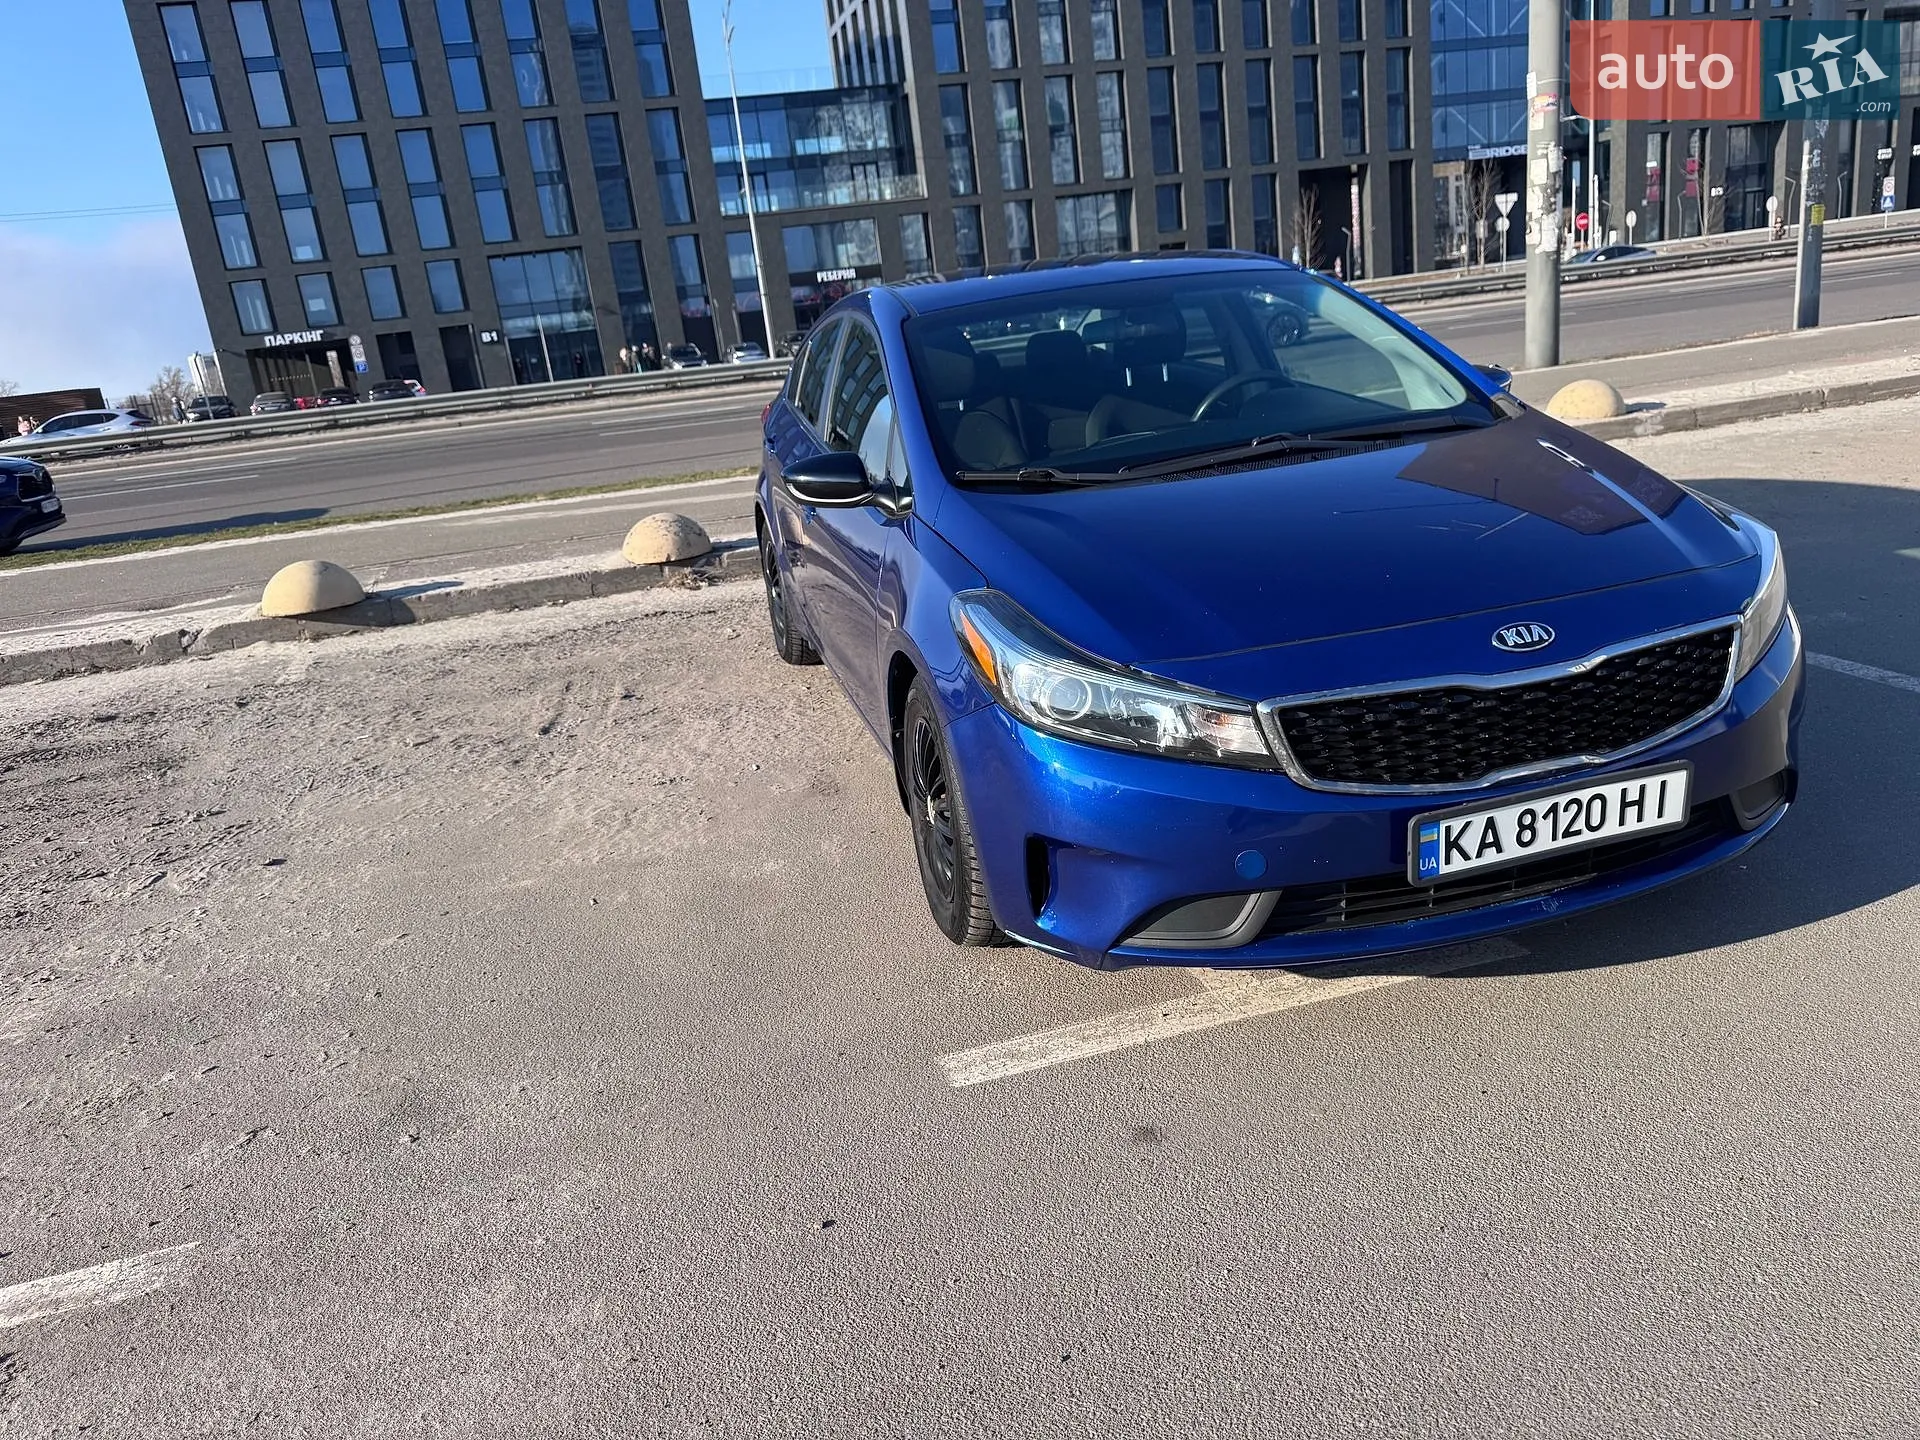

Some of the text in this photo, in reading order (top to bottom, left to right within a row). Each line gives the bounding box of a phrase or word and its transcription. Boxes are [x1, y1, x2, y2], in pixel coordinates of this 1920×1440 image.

[263, 329, 324, 348] ПАРКІНГ
[1500, 625, 1549, 646] KIA
[1444, 815, 1504, 866] KA
[1515, 793, 1608, 849] 8120
[1419, 856, 1438, 871] UA
